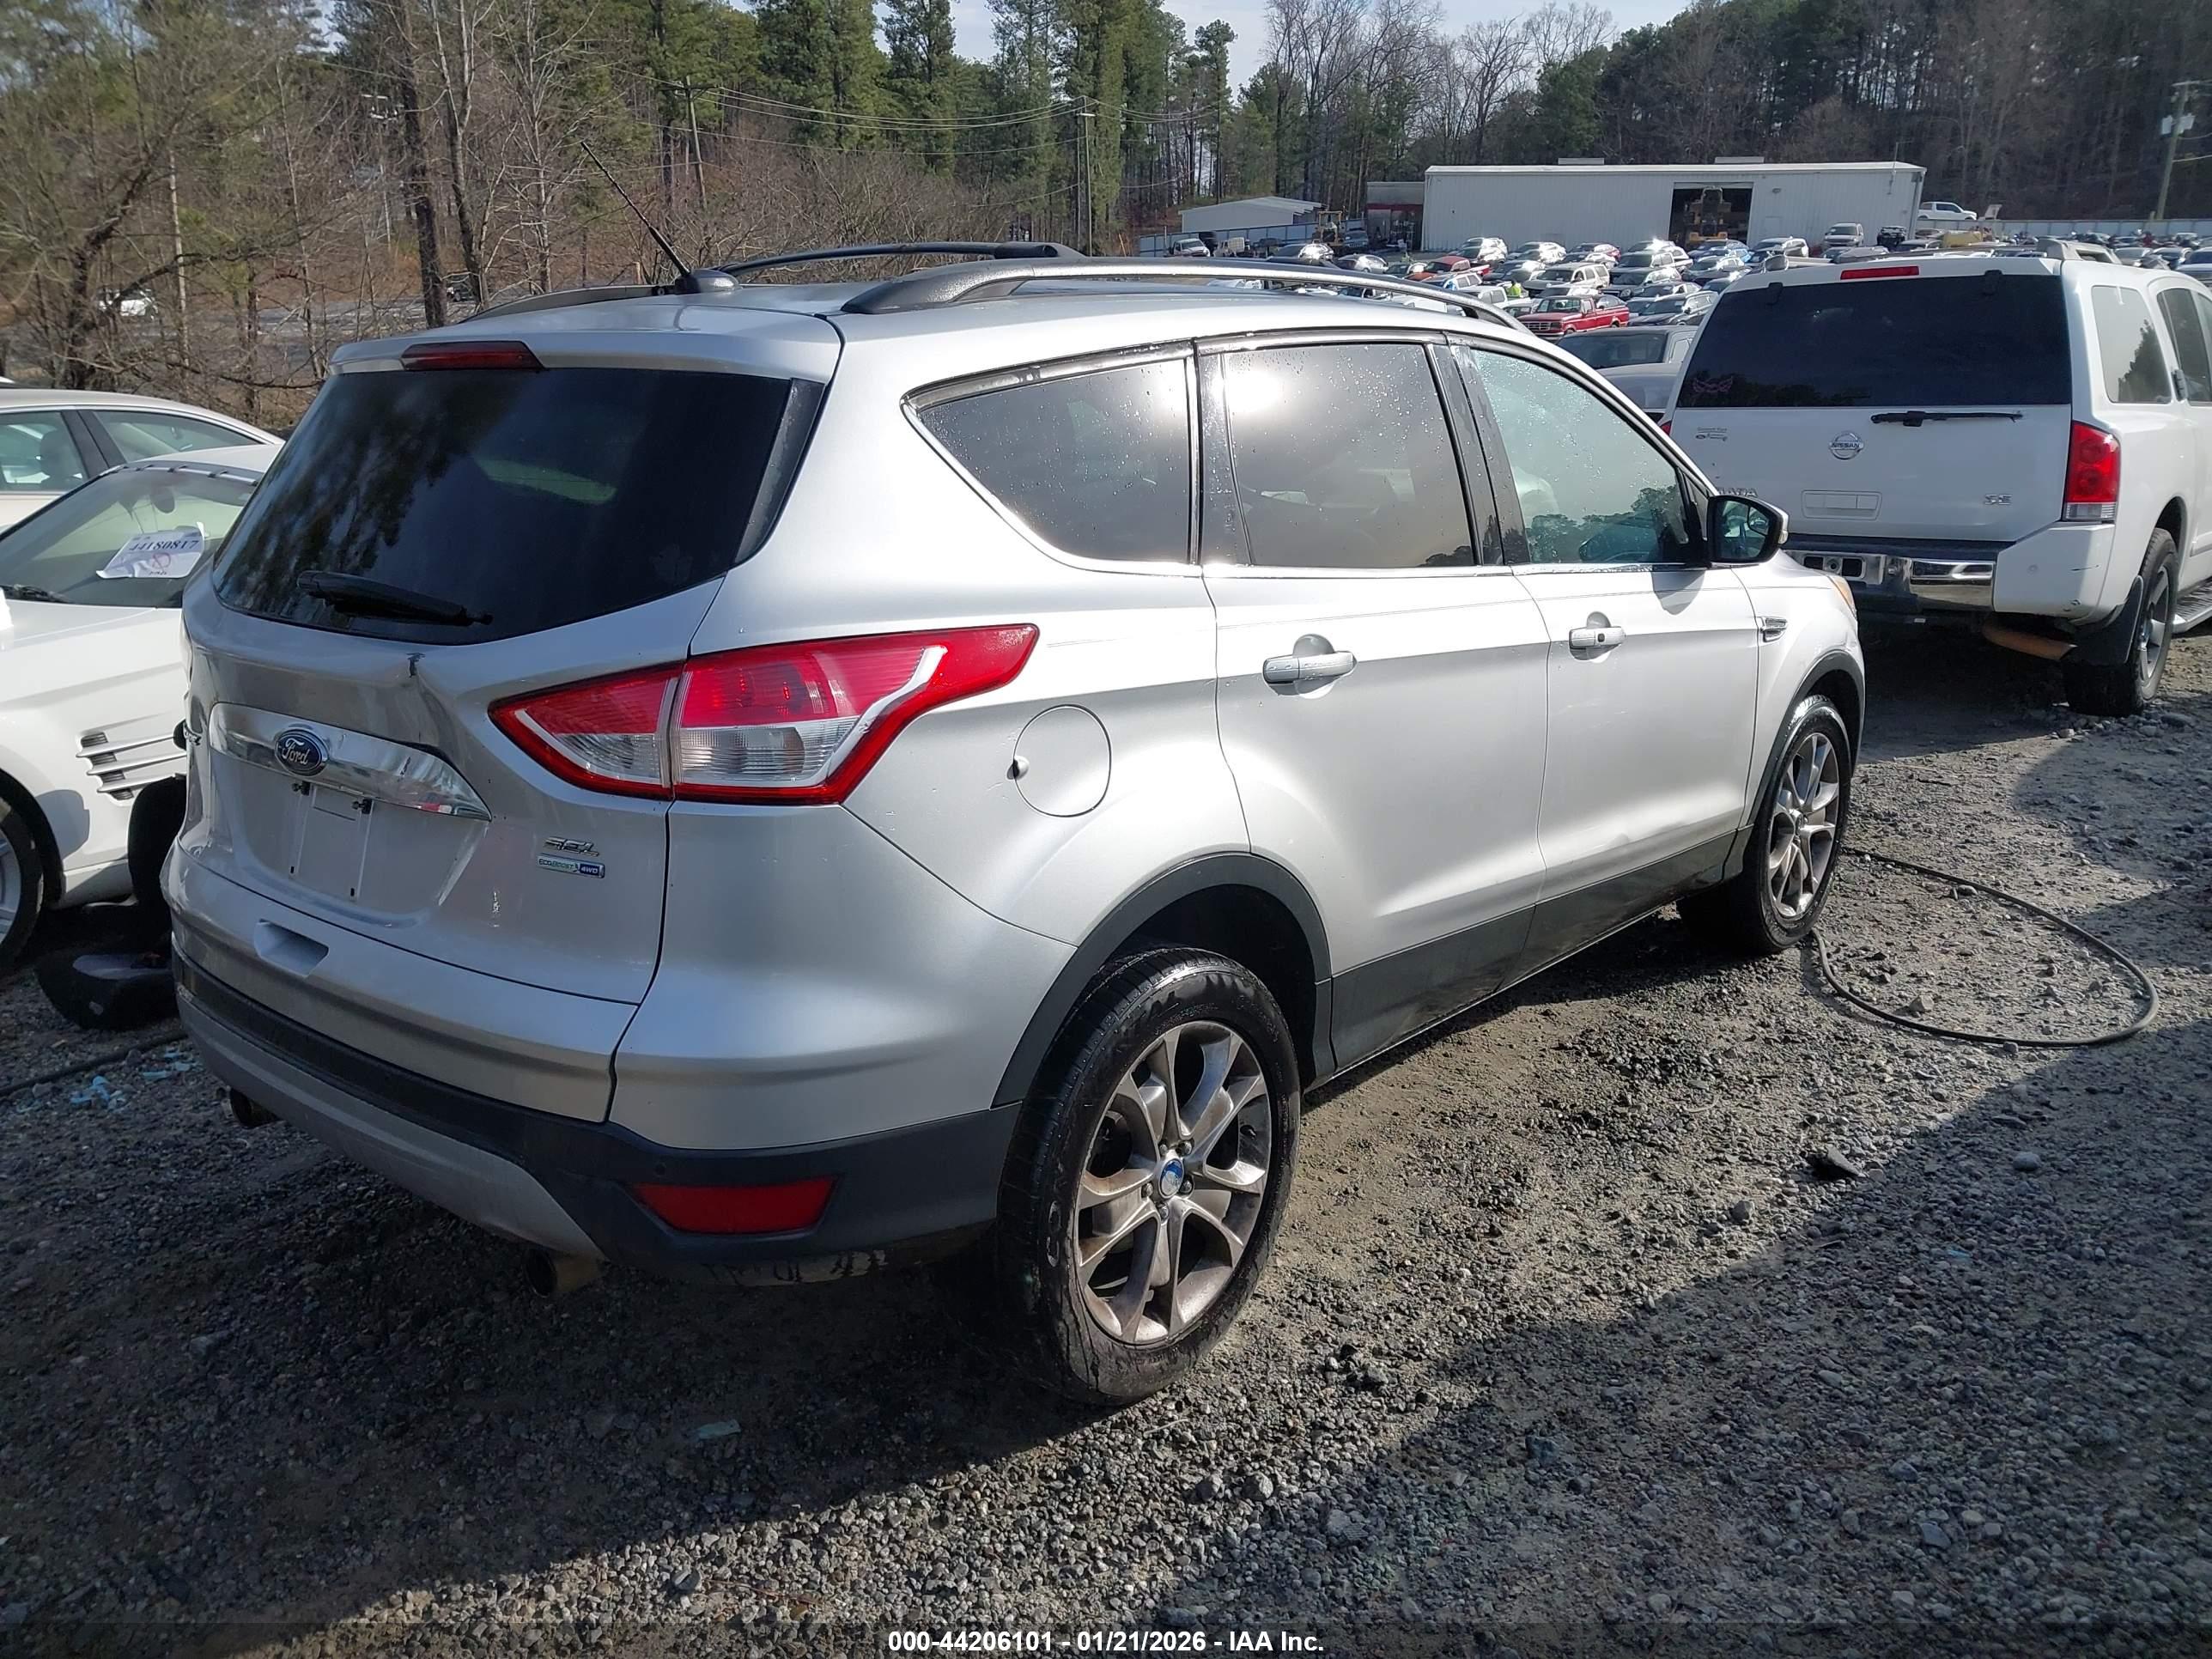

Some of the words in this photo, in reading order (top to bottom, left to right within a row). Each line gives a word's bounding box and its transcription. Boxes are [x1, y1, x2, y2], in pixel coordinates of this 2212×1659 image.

[1984, 493, 2012, 506] SE
[282, 738, 310, 765] Ford
[580, 865, 599, 874] 4WD
